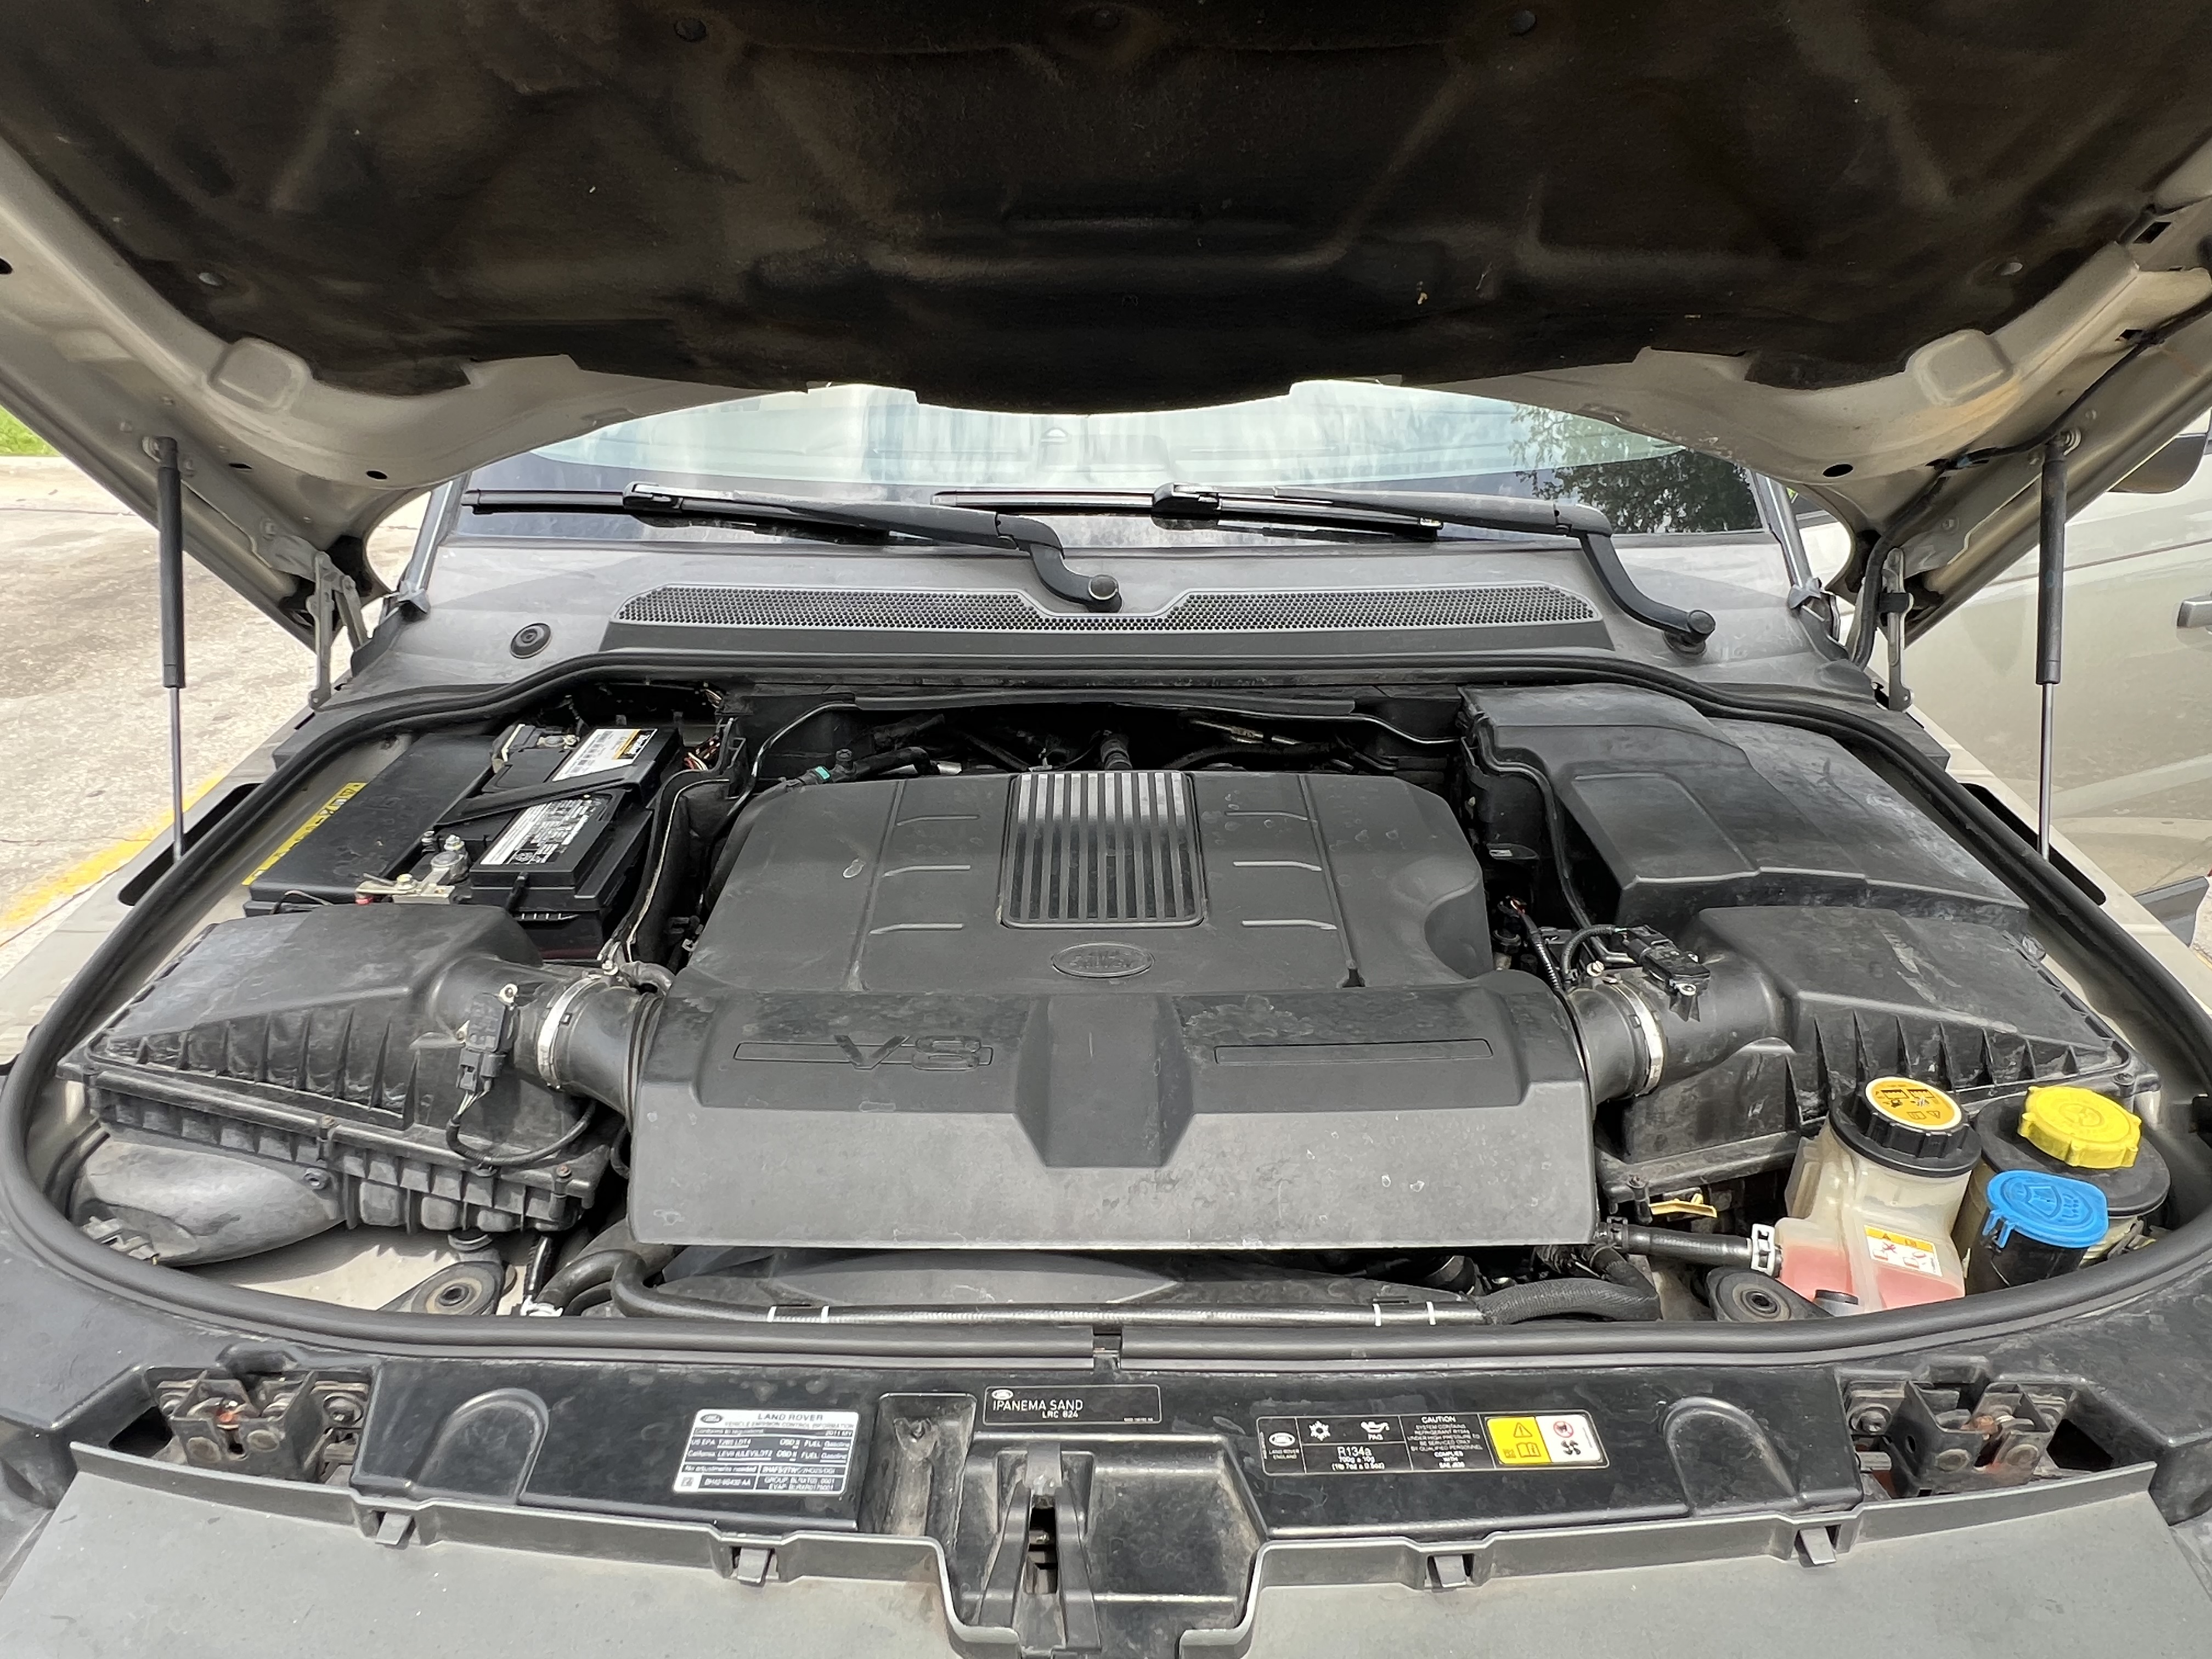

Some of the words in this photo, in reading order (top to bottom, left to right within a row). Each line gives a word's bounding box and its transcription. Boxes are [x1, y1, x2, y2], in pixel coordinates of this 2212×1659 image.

[833, 1035, 982, 1071] V8
[993, 1400, 1046, 1411] IPANEMA
[1050, 1399, 1083, 1410] SAND
[1042, 1410, 1059, 1419] LRC
[1337, 1446, 1372, 1457] R134a
